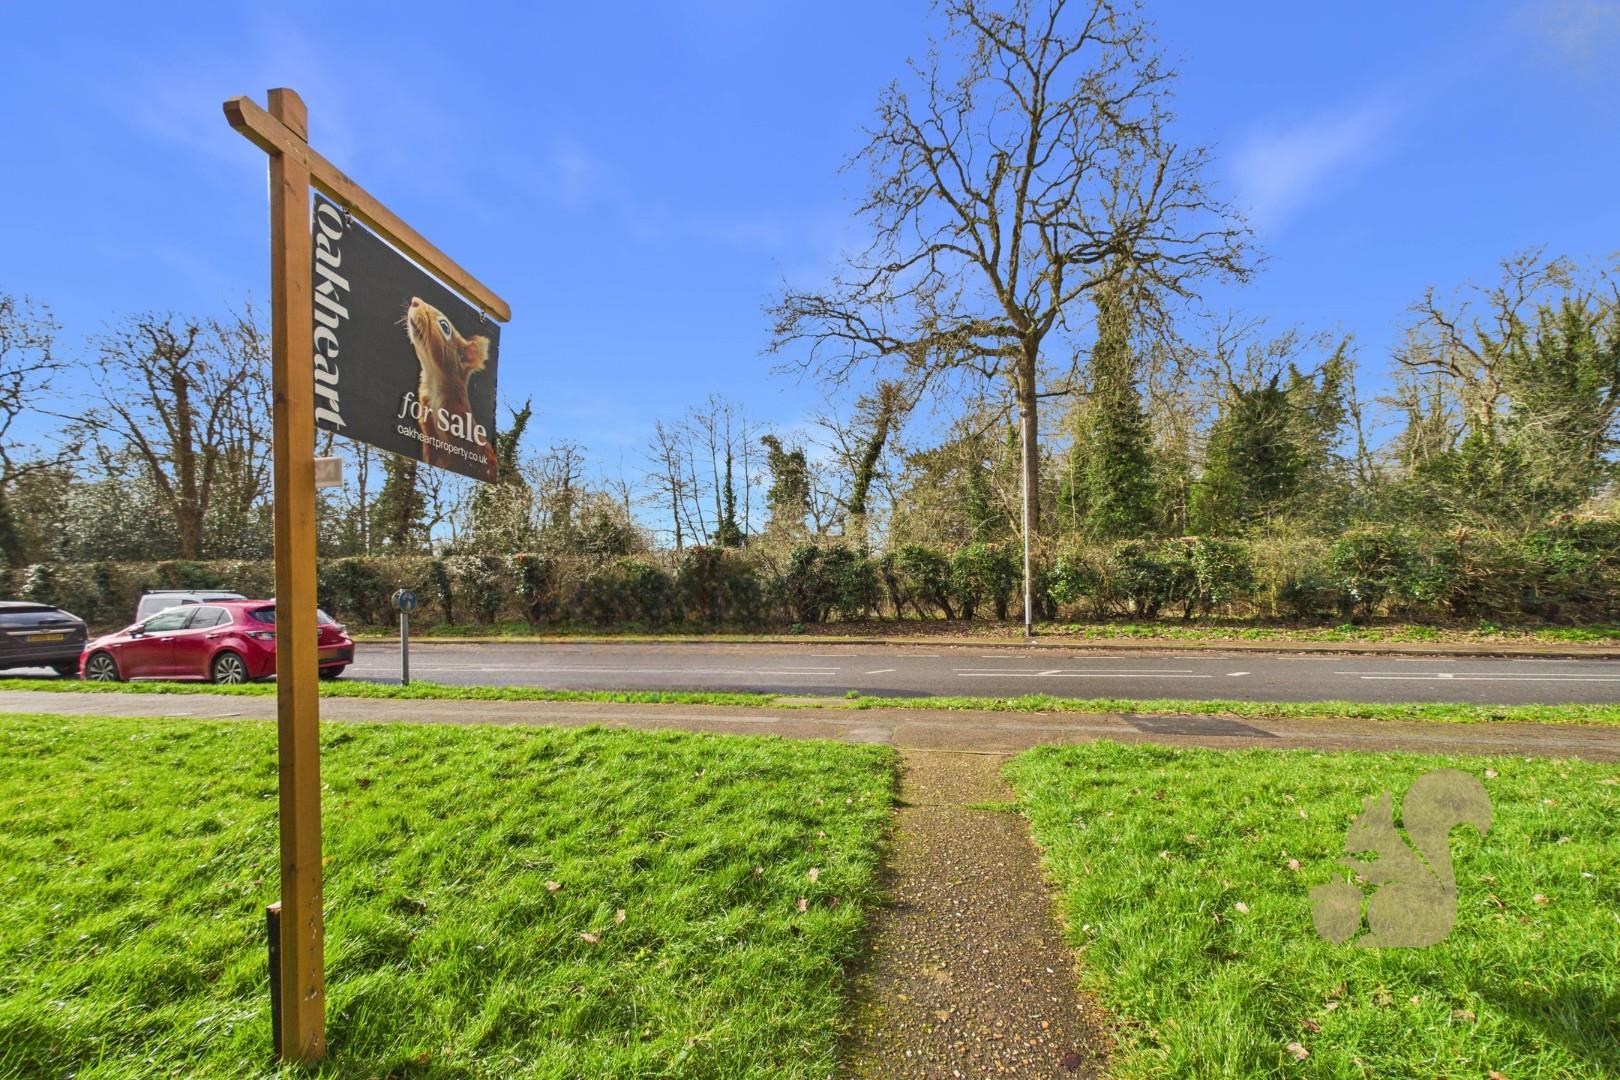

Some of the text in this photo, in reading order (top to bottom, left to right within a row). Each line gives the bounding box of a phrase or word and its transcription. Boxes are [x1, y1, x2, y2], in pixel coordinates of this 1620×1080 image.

[313, 203, 351, 431] Oakheart
[397, 391, 433, 423] for
[397, 424, 488, 464] oakheartproperty.co.uk
